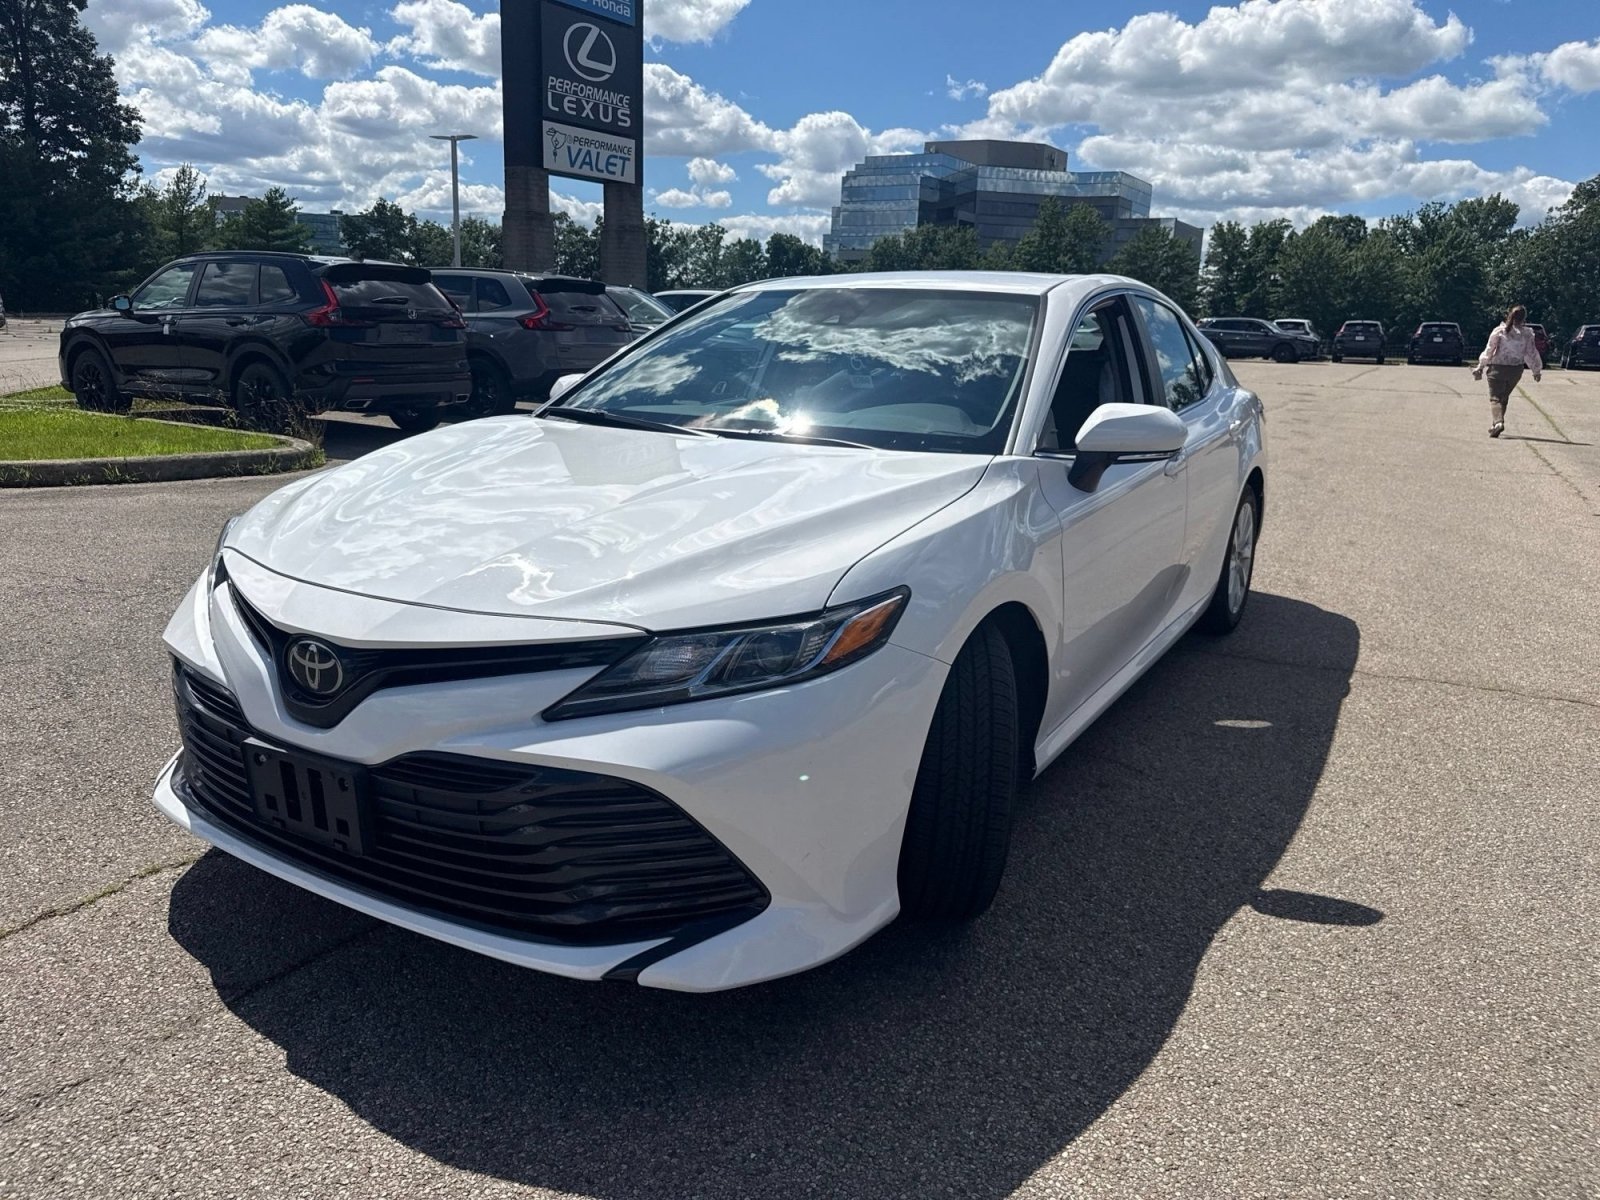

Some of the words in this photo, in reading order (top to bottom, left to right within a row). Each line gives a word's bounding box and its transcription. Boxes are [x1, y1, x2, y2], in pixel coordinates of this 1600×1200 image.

[548, 76, 630, 108] PERFORMANCE
[548, 91, 631, 127] LEXUS
[567, 145, 631, 177] VALET
[573, 136, 632, 156] PERFORMANCE
